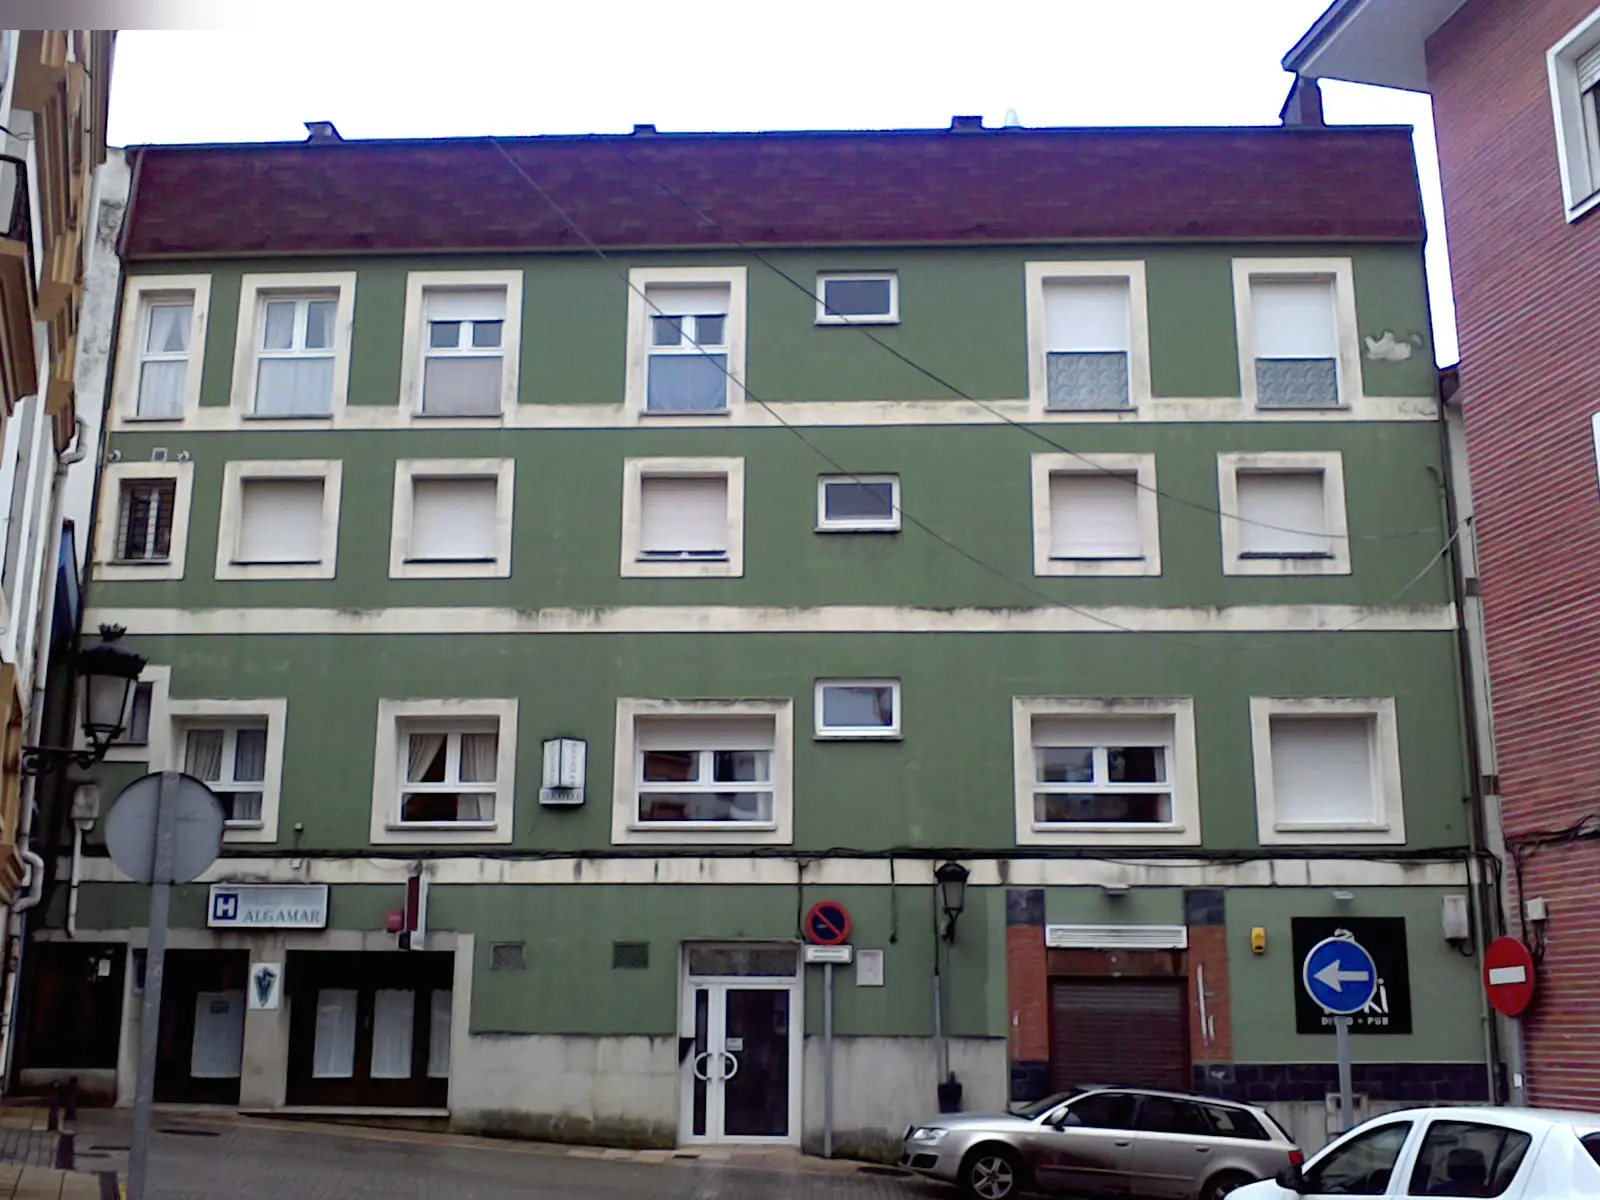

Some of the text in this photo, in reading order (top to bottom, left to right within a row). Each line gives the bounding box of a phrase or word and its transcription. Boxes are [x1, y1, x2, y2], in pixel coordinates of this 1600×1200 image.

[216, 897, 235, 917] H
[243, 908, 321, 923] ALGAMAR
[1321, 1016, 1389, 1026] DIO PUB
